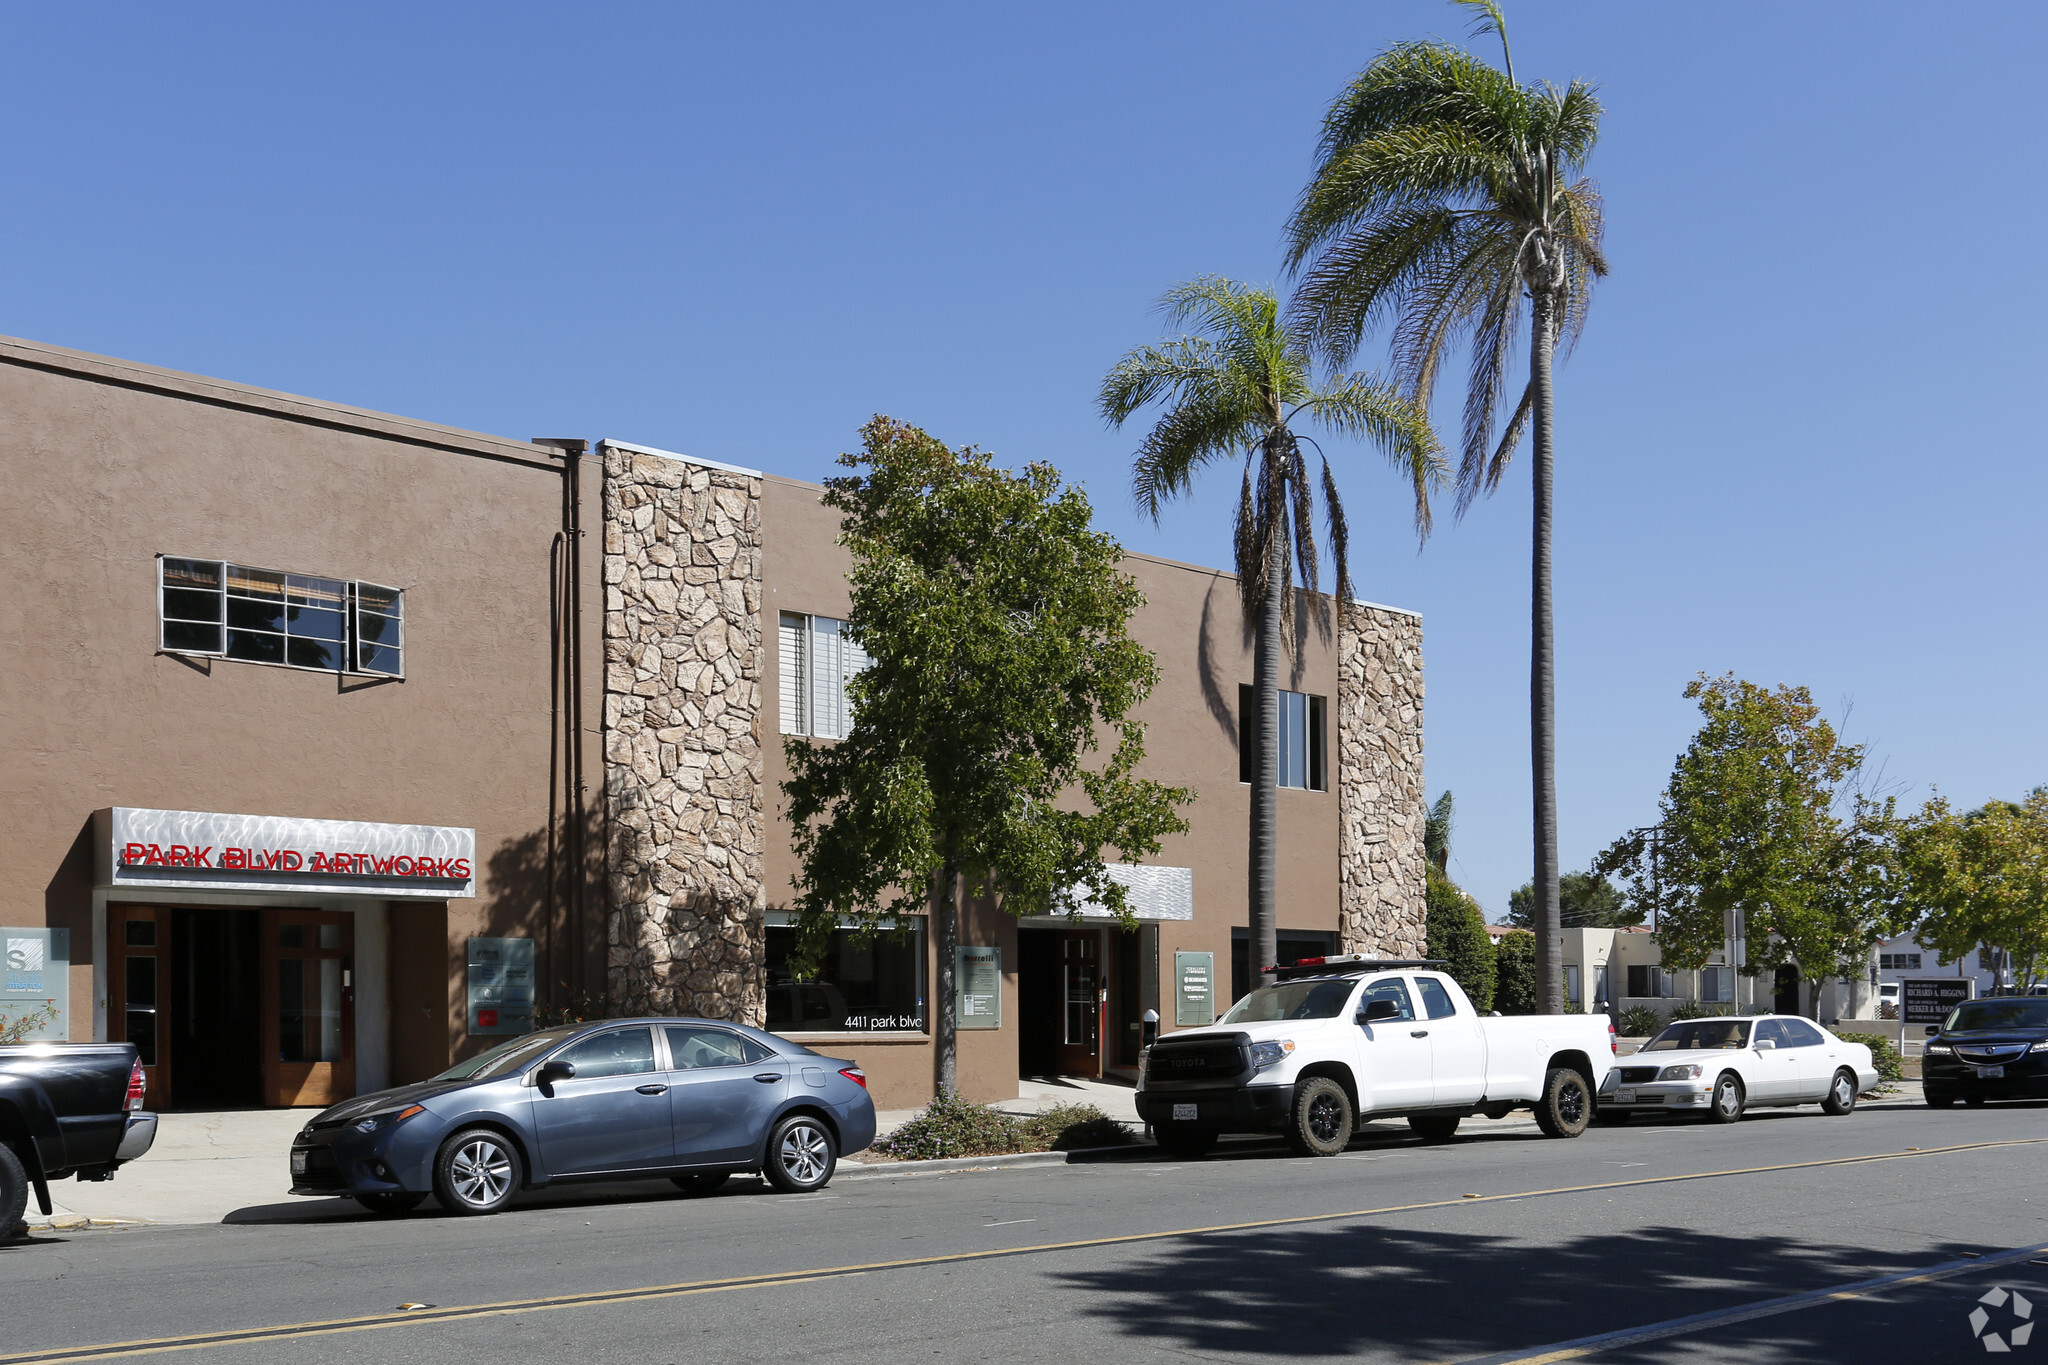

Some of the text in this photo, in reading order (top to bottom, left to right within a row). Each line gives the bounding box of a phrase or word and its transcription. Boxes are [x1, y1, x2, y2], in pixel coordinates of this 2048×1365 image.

[123, 843, 471, 879] PARK BLVD ARTWORKS
[1940, 989, 1966, 998] HIGGINS
[1907, 1005, 1929, 1013] MERKER
[844, 1015, 867, 1028] 4411
[870, 1015, 897, 1031] park
[1171, 1058, 1206, 1069] TOYOTA
